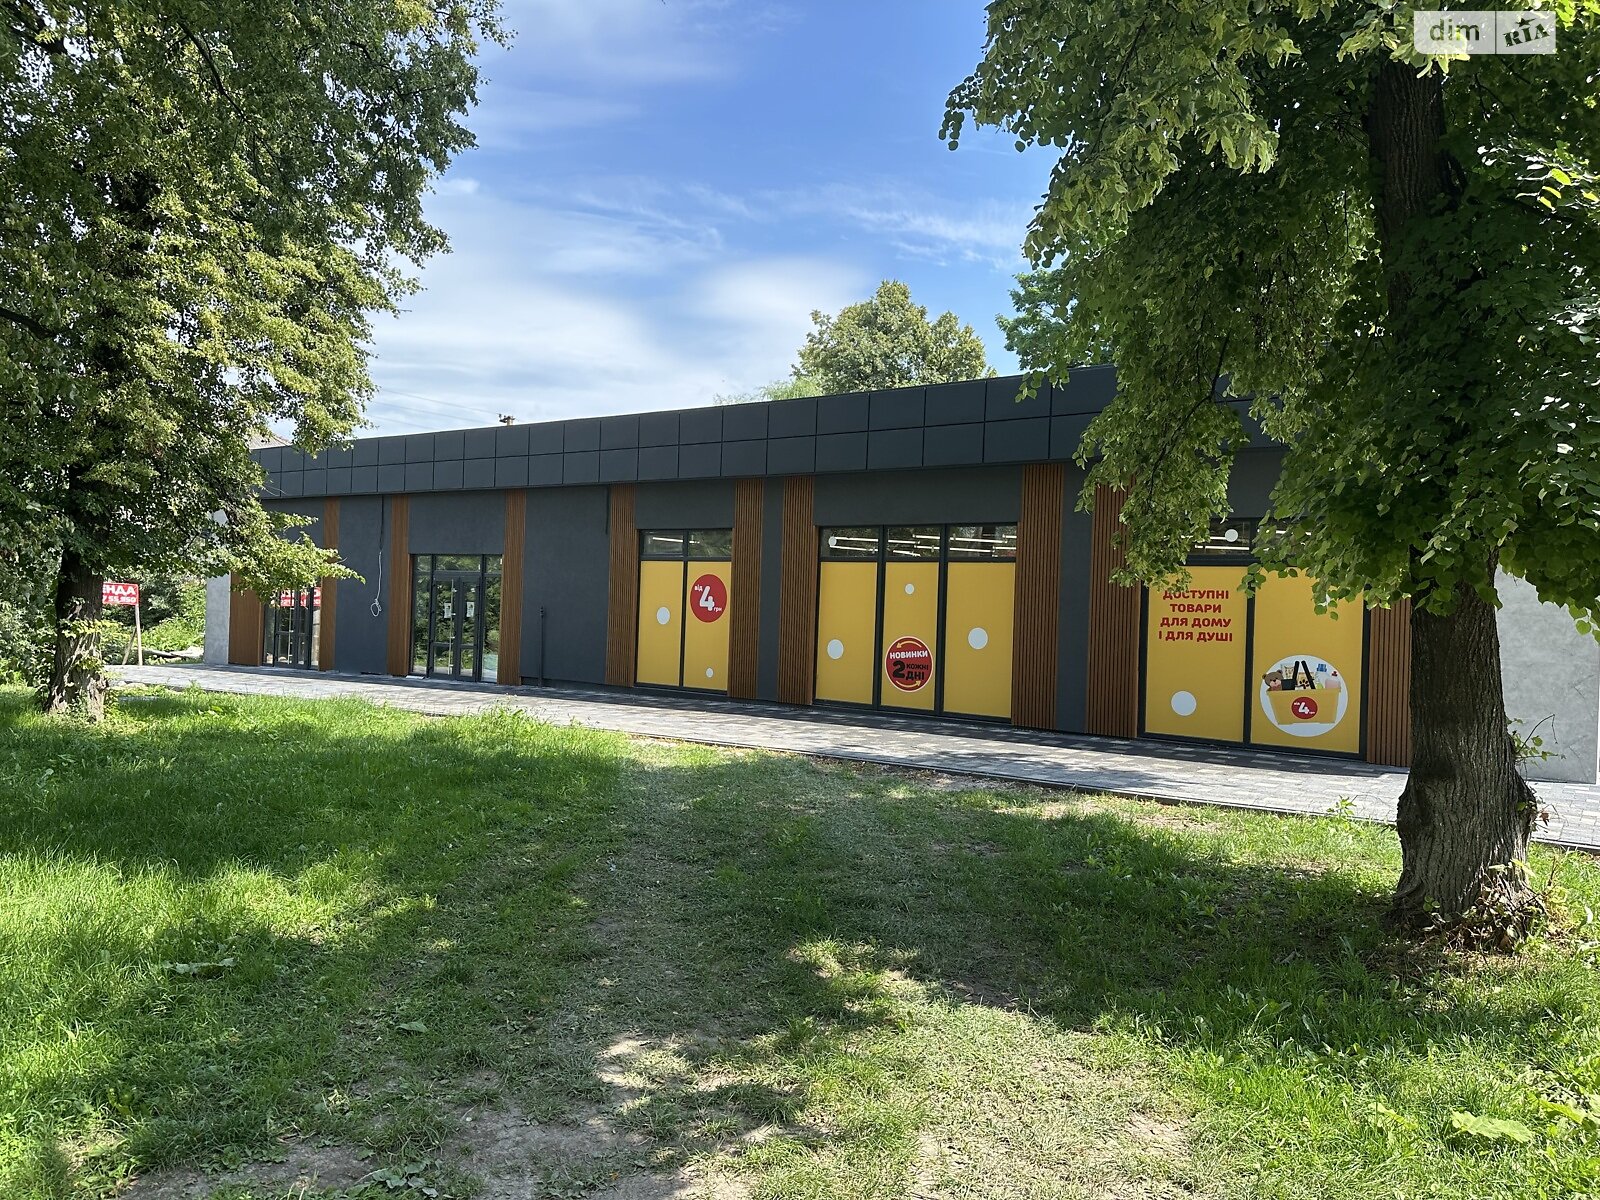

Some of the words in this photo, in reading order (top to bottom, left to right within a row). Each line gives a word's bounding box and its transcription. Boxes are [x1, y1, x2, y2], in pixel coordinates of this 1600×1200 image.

[699, 585, 715, 611] 4
[1162, 590, 1229, 600] ДОСТУПНІ
[1169, 603, 1222, 613] ТОВАРИ
[1160, 617, 1188, 627] ДЛЯ
[1191, 618, 1232, 628] ДОМУ
[1158, 631, 1162, 640] І
[1165, 631, 1194, 641] ДЛЯ
[1197, 632, 1233, 642] ДУШІ
[889, 650, 928, 659] НОВИНКИ
[892, 660, 906, 679] 2
[905, 670, 925, 680] ДНІ
[1298, 701, 1309, 714] 4
